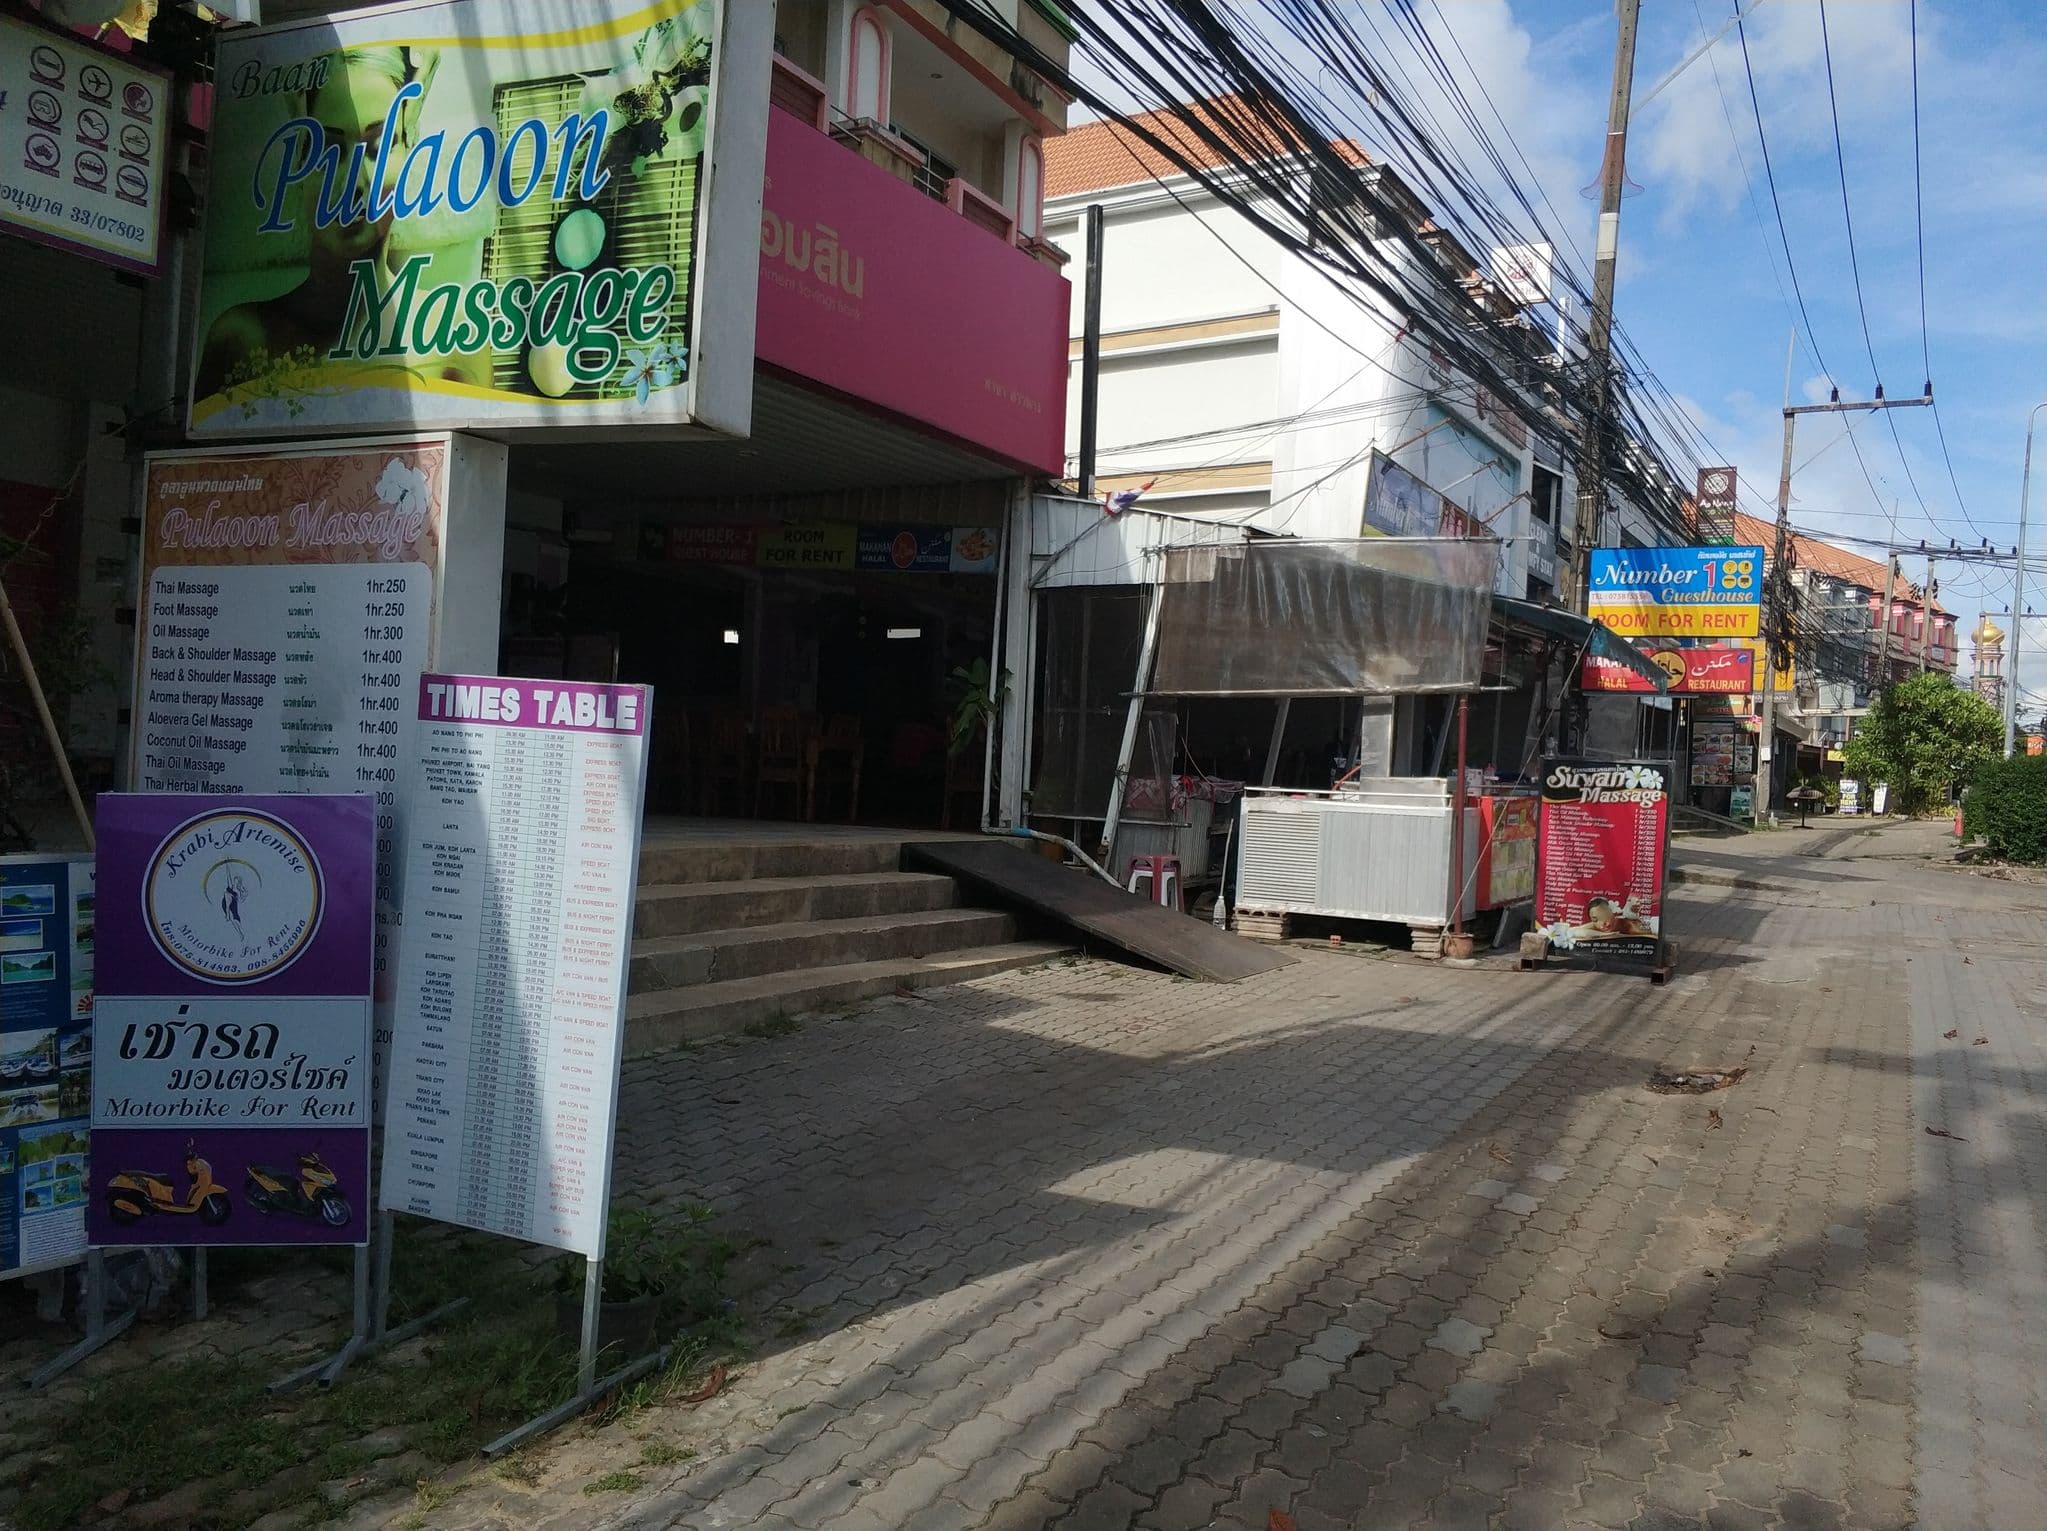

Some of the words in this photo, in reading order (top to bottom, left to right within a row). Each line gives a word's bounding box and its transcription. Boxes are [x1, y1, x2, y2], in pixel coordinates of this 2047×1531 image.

[231, 56, 330, 98] Baan
[253, 81, 610, 234] Pulaoon
[70, 206, 145, 242] 33/07802
[328, 255, 676, 384] Massage
[160, 500, 280, 548] Pulaoon
[286, 500, 424, 560] Massage
[783, 529, 825, 544] ROOM
[766, 549, 796, 562] FOR
[801, 550, 843, 564] RENT
[1596, 560, 1698, 585] Number
[1703, 561, 1717, 588] 1
[155, 581, 176, 594] Thai
[178, 582, 219, 598] Massage
[366, 580, 406, 594] 1hr.250
[1661, 588, 1754, 604] Guesthouse
[154, 603, 175, 616] Foot
[177, 604, 219, 620] Massage
[365, 603, 404, 617] 1hr.250
[1596, 614, 1649, 629] ROOM
[1659, 614, 1694, 628] FOR
[1703, 613, 1750, 628] RENT
[153, 626, 167, 638] Oil
[168, 626, 209, 641] Massage
[364, 627, 403, 641] 1hr.300
[151, 647, 175, 660] Back
[177, 648, 184, 660] &
[187, 647, 230, 661] Shoulder
[233, 648, 276, 664] Massage
[362, 650, 402, 664] 1hr.400
[151, 669, 175, 681] Head
[177, 670, 184, 682] &
[187, 669, 230, 684] Shoulder
[233, 671, 276, 687] Massage
[361, 673, 400, 687] 1hr.400
[1688, 679, 1746, 691] RESTAURANT
[149, 690, 180, 703] Aroma
[182, 690, 218, 707] therapy
[220, 693, 264, 709] Massage
[359, 697, 399, 711] 1hr.400
[427, 683, 520, 722] TIMES
[533, 689, 637, 730] TABLE
[148, 712, 189, 726] Aloevera
[192, 713, 208, 727] Gel
[210, 715, 253, 731] Massage
[358, 720, 398, 734] 1hr.400
[147, 733, 186, 748] Coconut
[189, 735, 202, 748] Oil
[204, 737, 246, 753] Massage
[357, 744, 396, 758] 1hr.400
[145, 755, 165, 768] Thai
[168, 756, 181, 769] Oil
[183, 757, 225, 773] Massage
[355, 768, 395, 782] 1hr.400
[1546, 766, 1625, 788] Suwan
[144, 776, 165, 789] Thai
[168, 777, 199, 791] Herbal
[201, 780, 243, 794] Massage
[1579, 787, 1662, 808] Massage
[167, 827, 213, 878] Krabi
[214, 821, 306, 873] Artemise
[178, 924, 234, 959] Motorbike
[268, 924, 291, 948] Rent
[118, 1004, 280, 1060] เช่ารถ
[167, 1052, 356, 1090] มอเตอร์ไซค์
[103, 1097, 230, 1117] Motorbike
[240, 1095, 288, 1117] For
[300, 1095, 356, 1119] Rent
